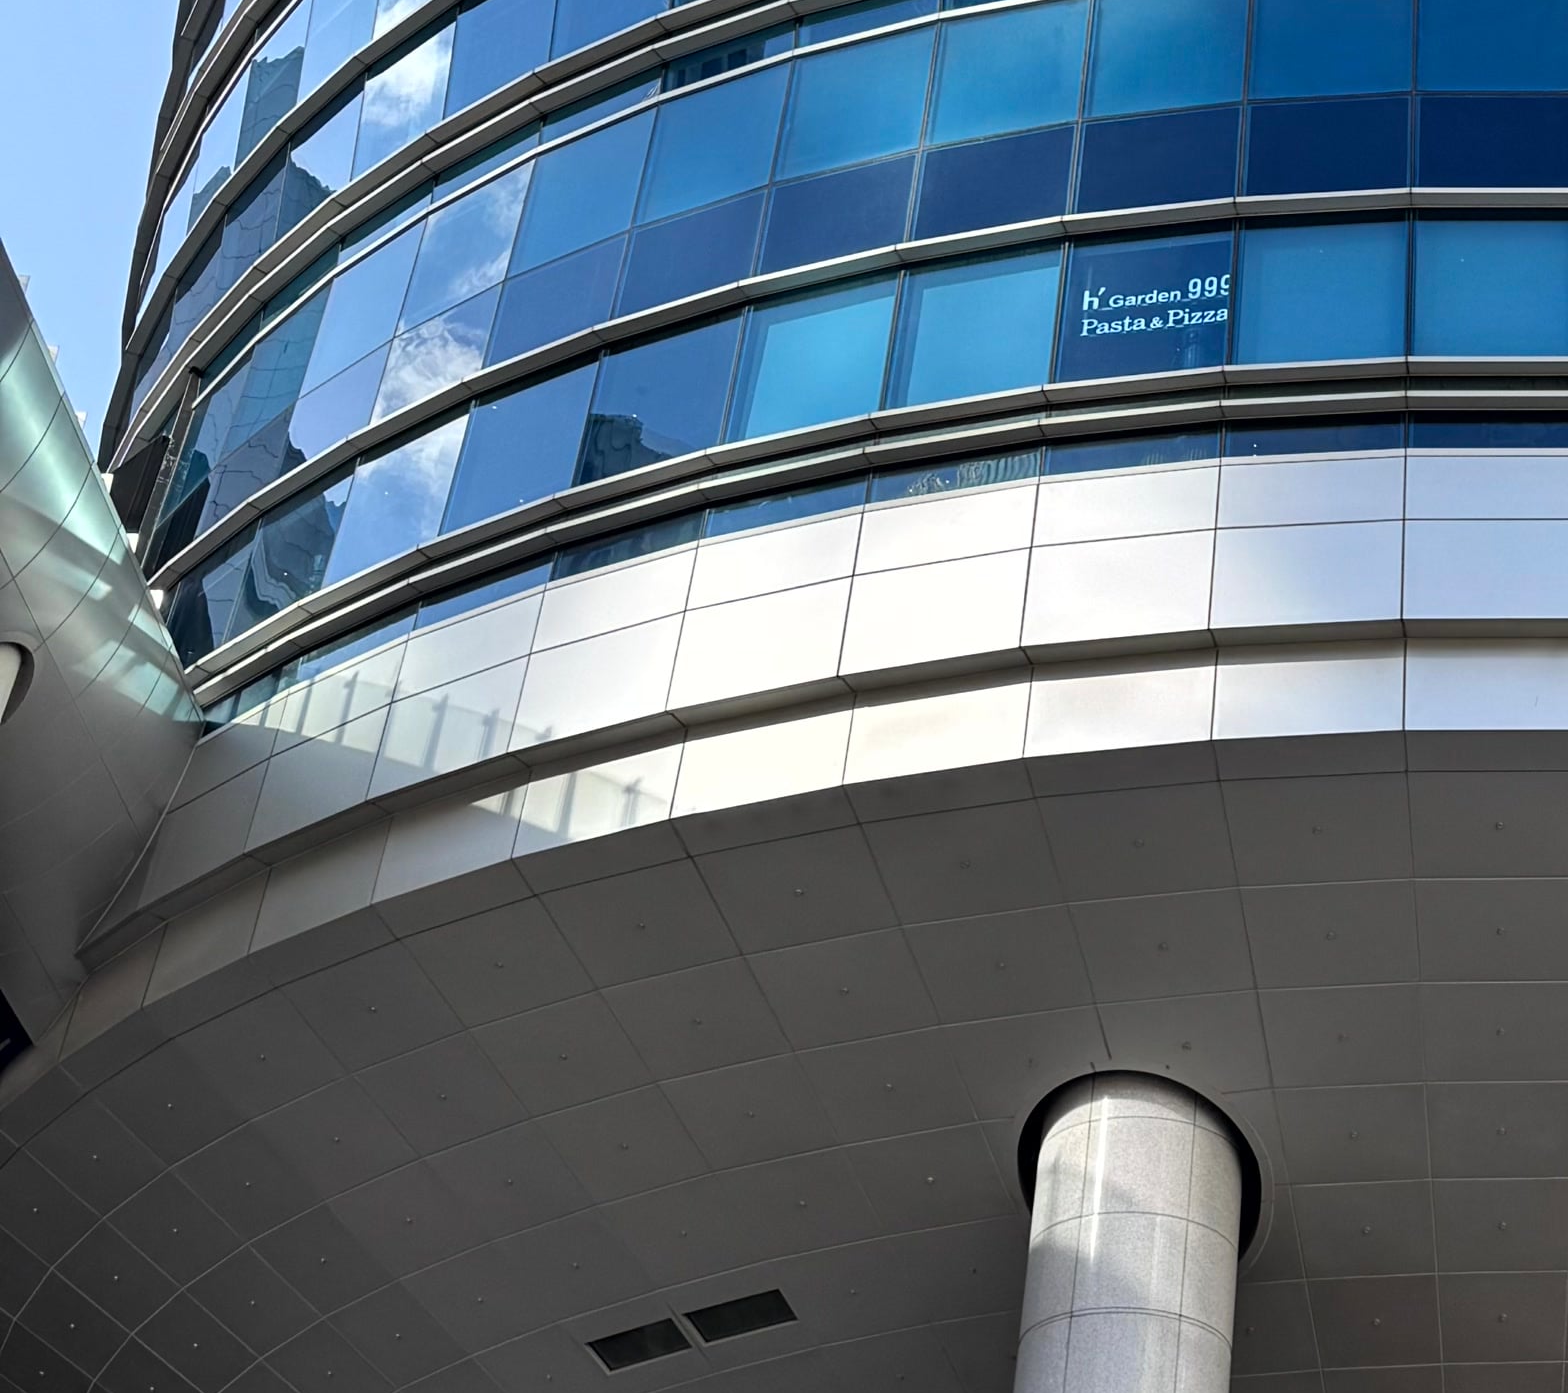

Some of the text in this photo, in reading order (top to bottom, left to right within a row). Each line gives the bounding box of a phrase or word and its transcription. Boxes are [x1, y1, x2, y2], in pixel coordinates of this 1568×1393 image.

[1188, 274, 1231, 300] 999
[1080, 308, 1228, 337] Pasta & Pizza
